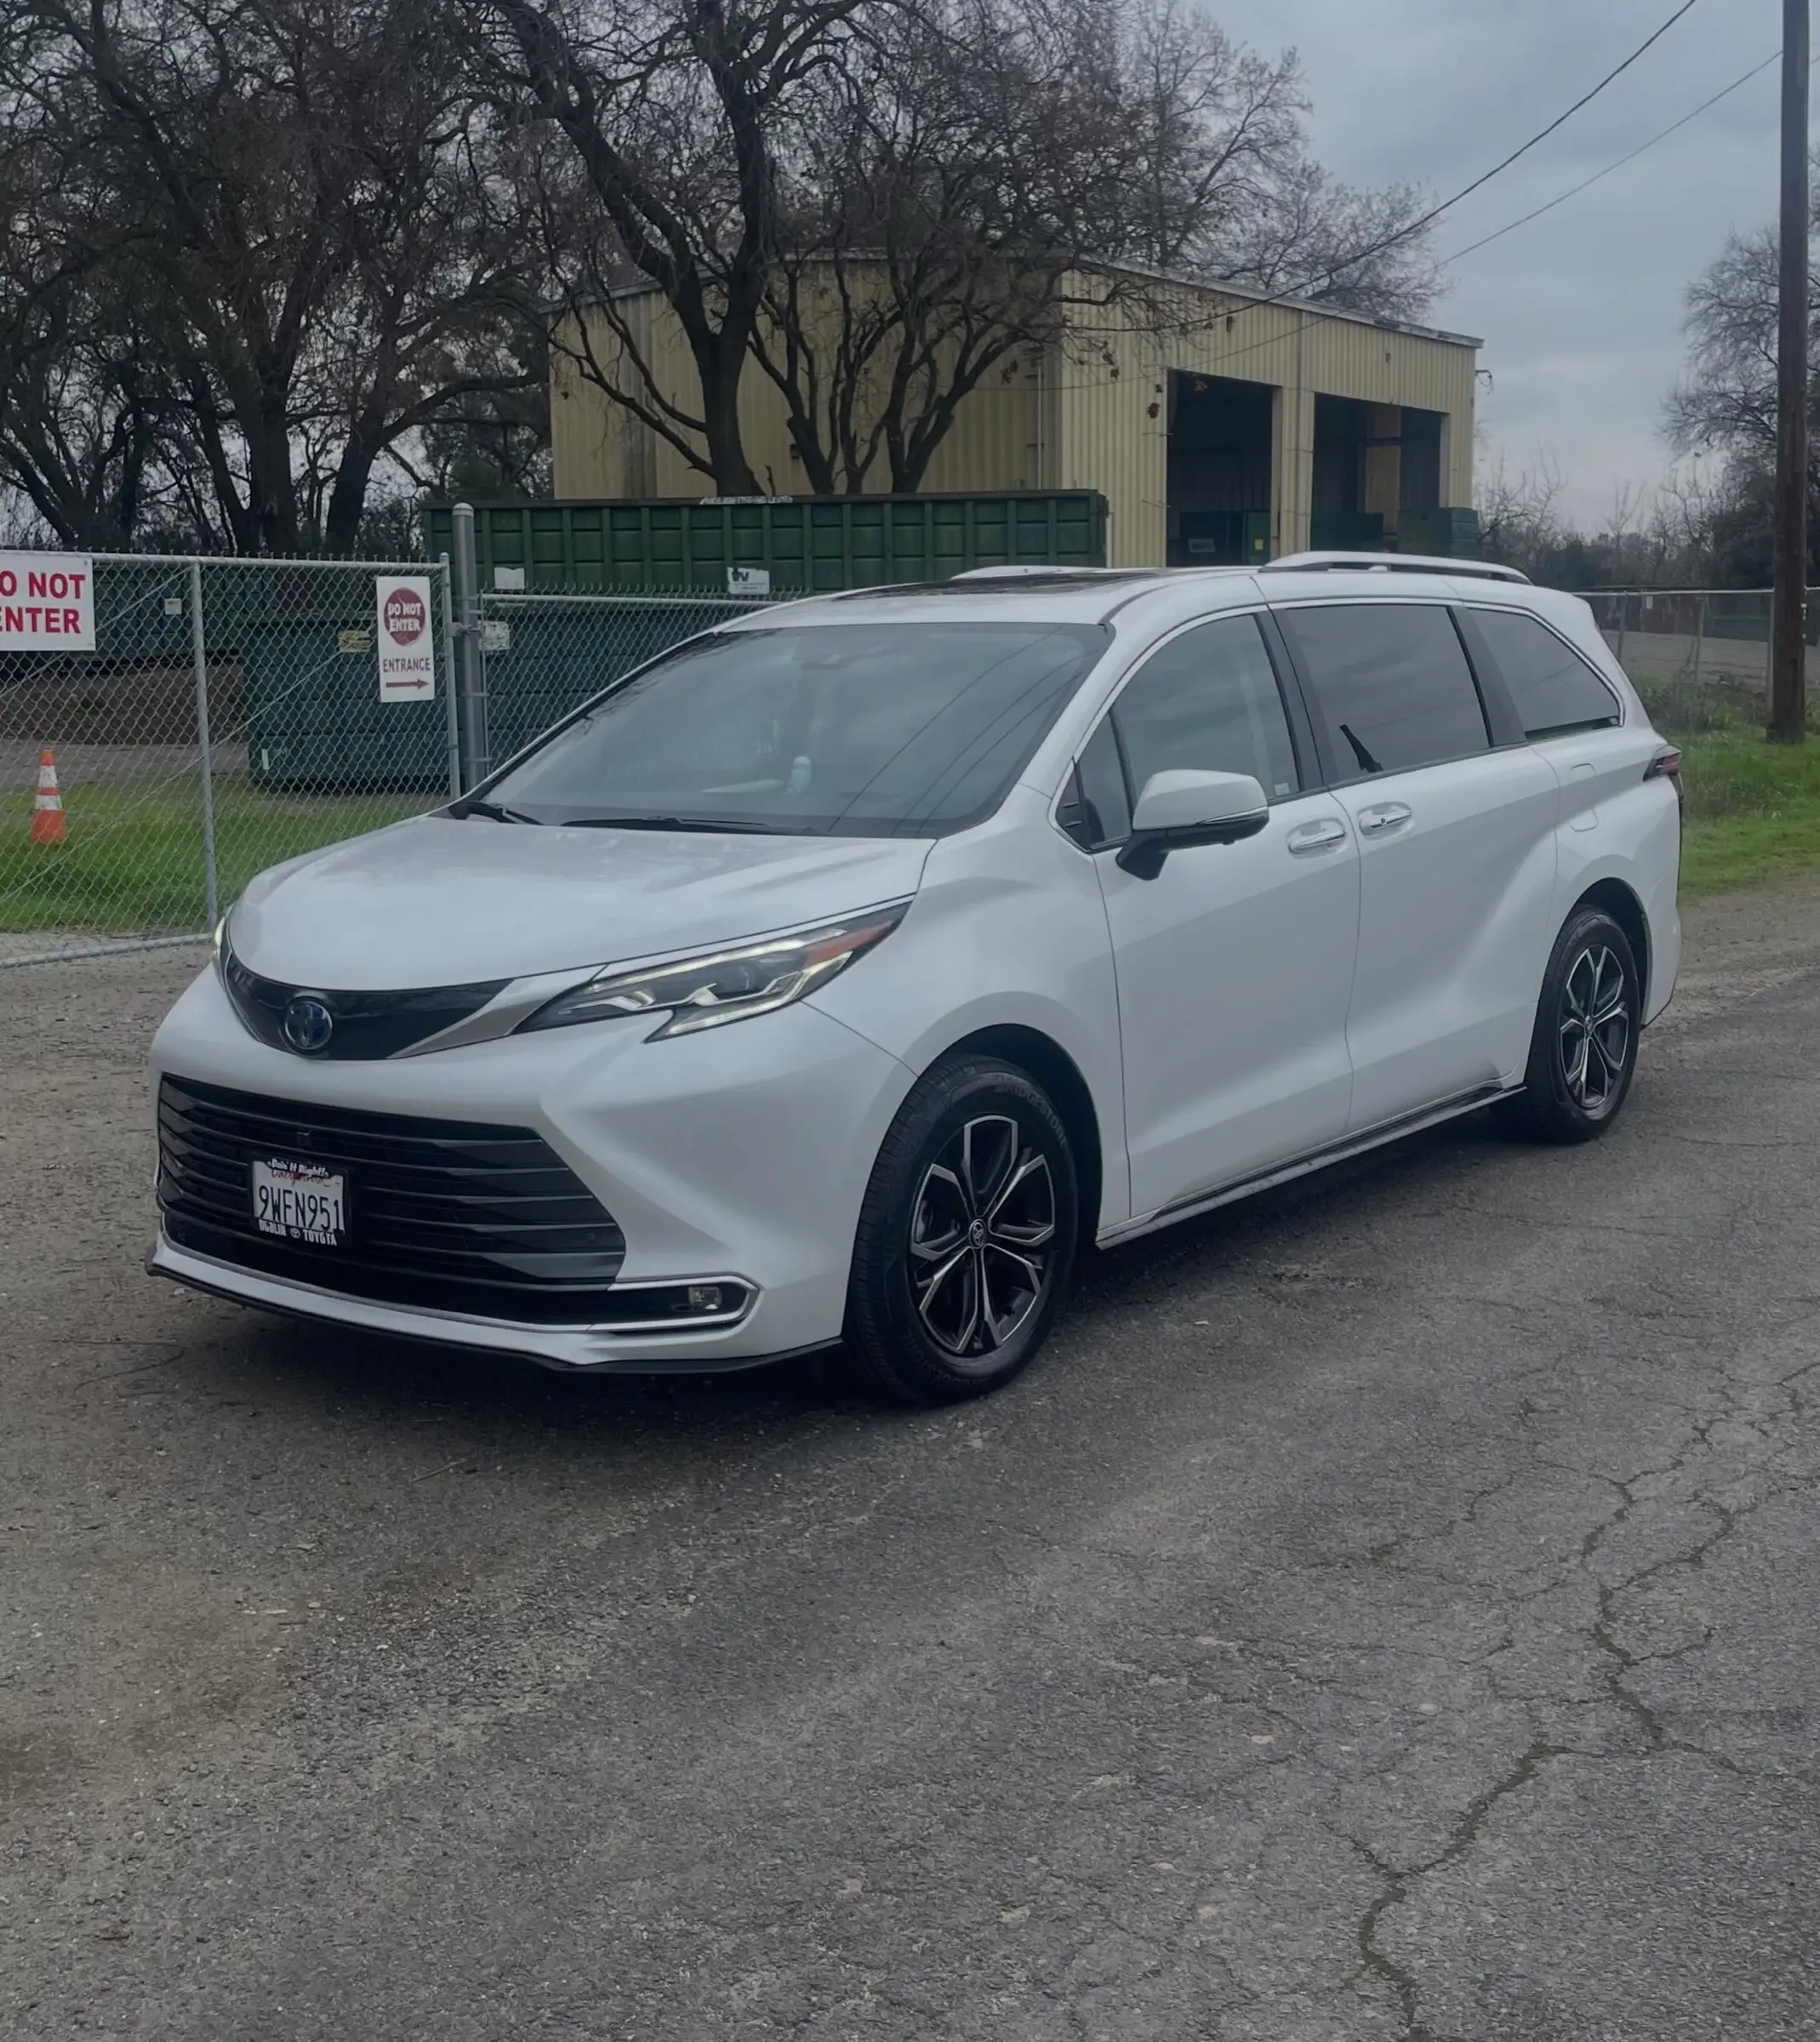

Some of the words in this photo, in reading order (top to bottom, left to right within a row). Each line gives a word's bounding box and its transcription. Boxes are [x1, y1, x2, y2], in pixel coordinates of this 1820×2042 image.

[0, 570, 17, 596] O
[28, 571, 86, 599] NOT
[387, 602, 401, 615] DO
[402, 602, 422, 616] NOT
[0, 606, 81, 634] NTER
[389, 618, 421, 632] ENTER
[383, 658, 431, 673] ENTRANCE
[259, 1185, 342, 1233] 9WFN951
[303, 1229, 337, 1246] TOYOTA
